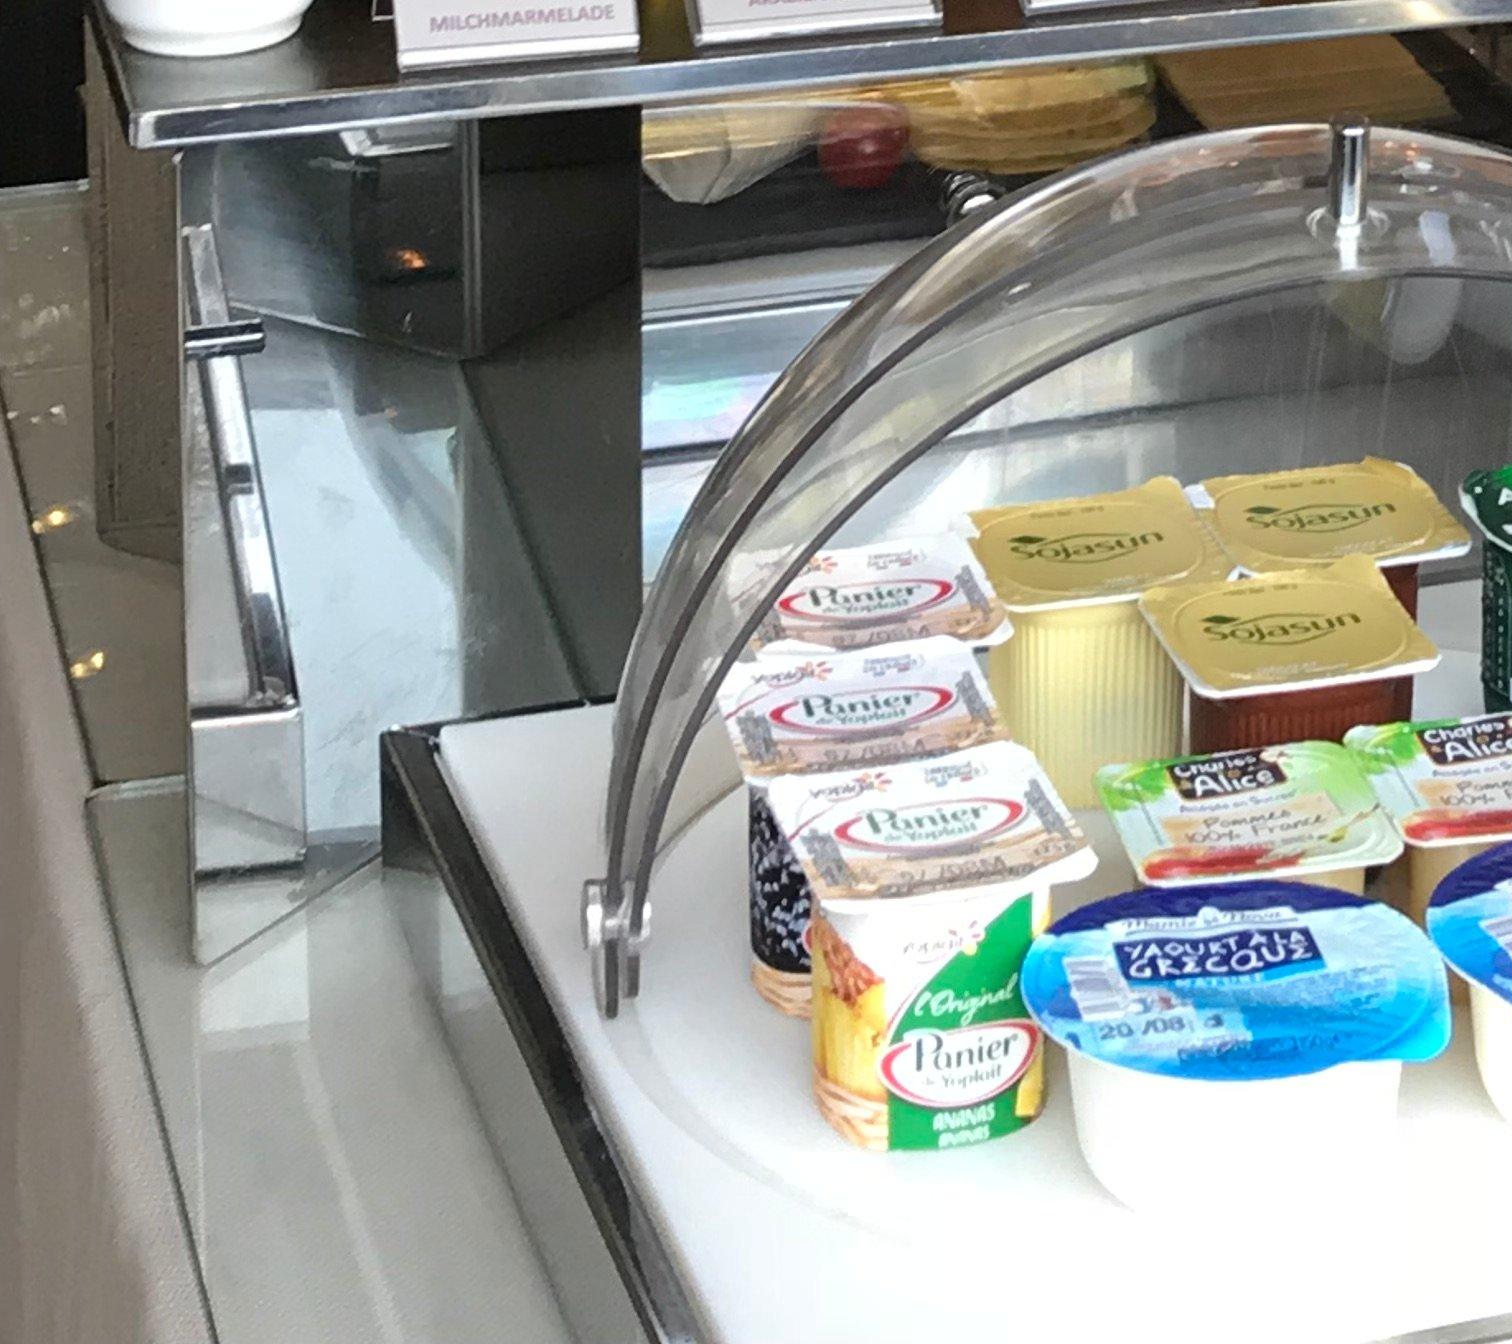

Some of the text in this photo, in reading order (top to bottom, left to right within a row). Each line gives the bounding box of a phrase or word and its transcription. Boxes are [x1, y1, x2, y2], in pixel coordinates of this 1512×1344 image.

[430, 4, 615, 33] MILCHMARMELADE
[806, 584, 922, 608] Panier
[801, 693, 915, 718] Panier
[1424, 721, 1506, 744] Charles
[1173, 753, 1257, 778] Charles
[1193, 769, 1275, 797] Alice
[860, 805, 985, 834] Panier
[1204, 809, 1292, 829] Pommes
[1251, 814, 1327, 836] France
[1124, 934, 1239, 962] YAOURT
[1272, 927, 1307, 946] LA
[1129, 942, 1313, 979] GRECQUE
[914, 1032, 1013, 1072] Panier
